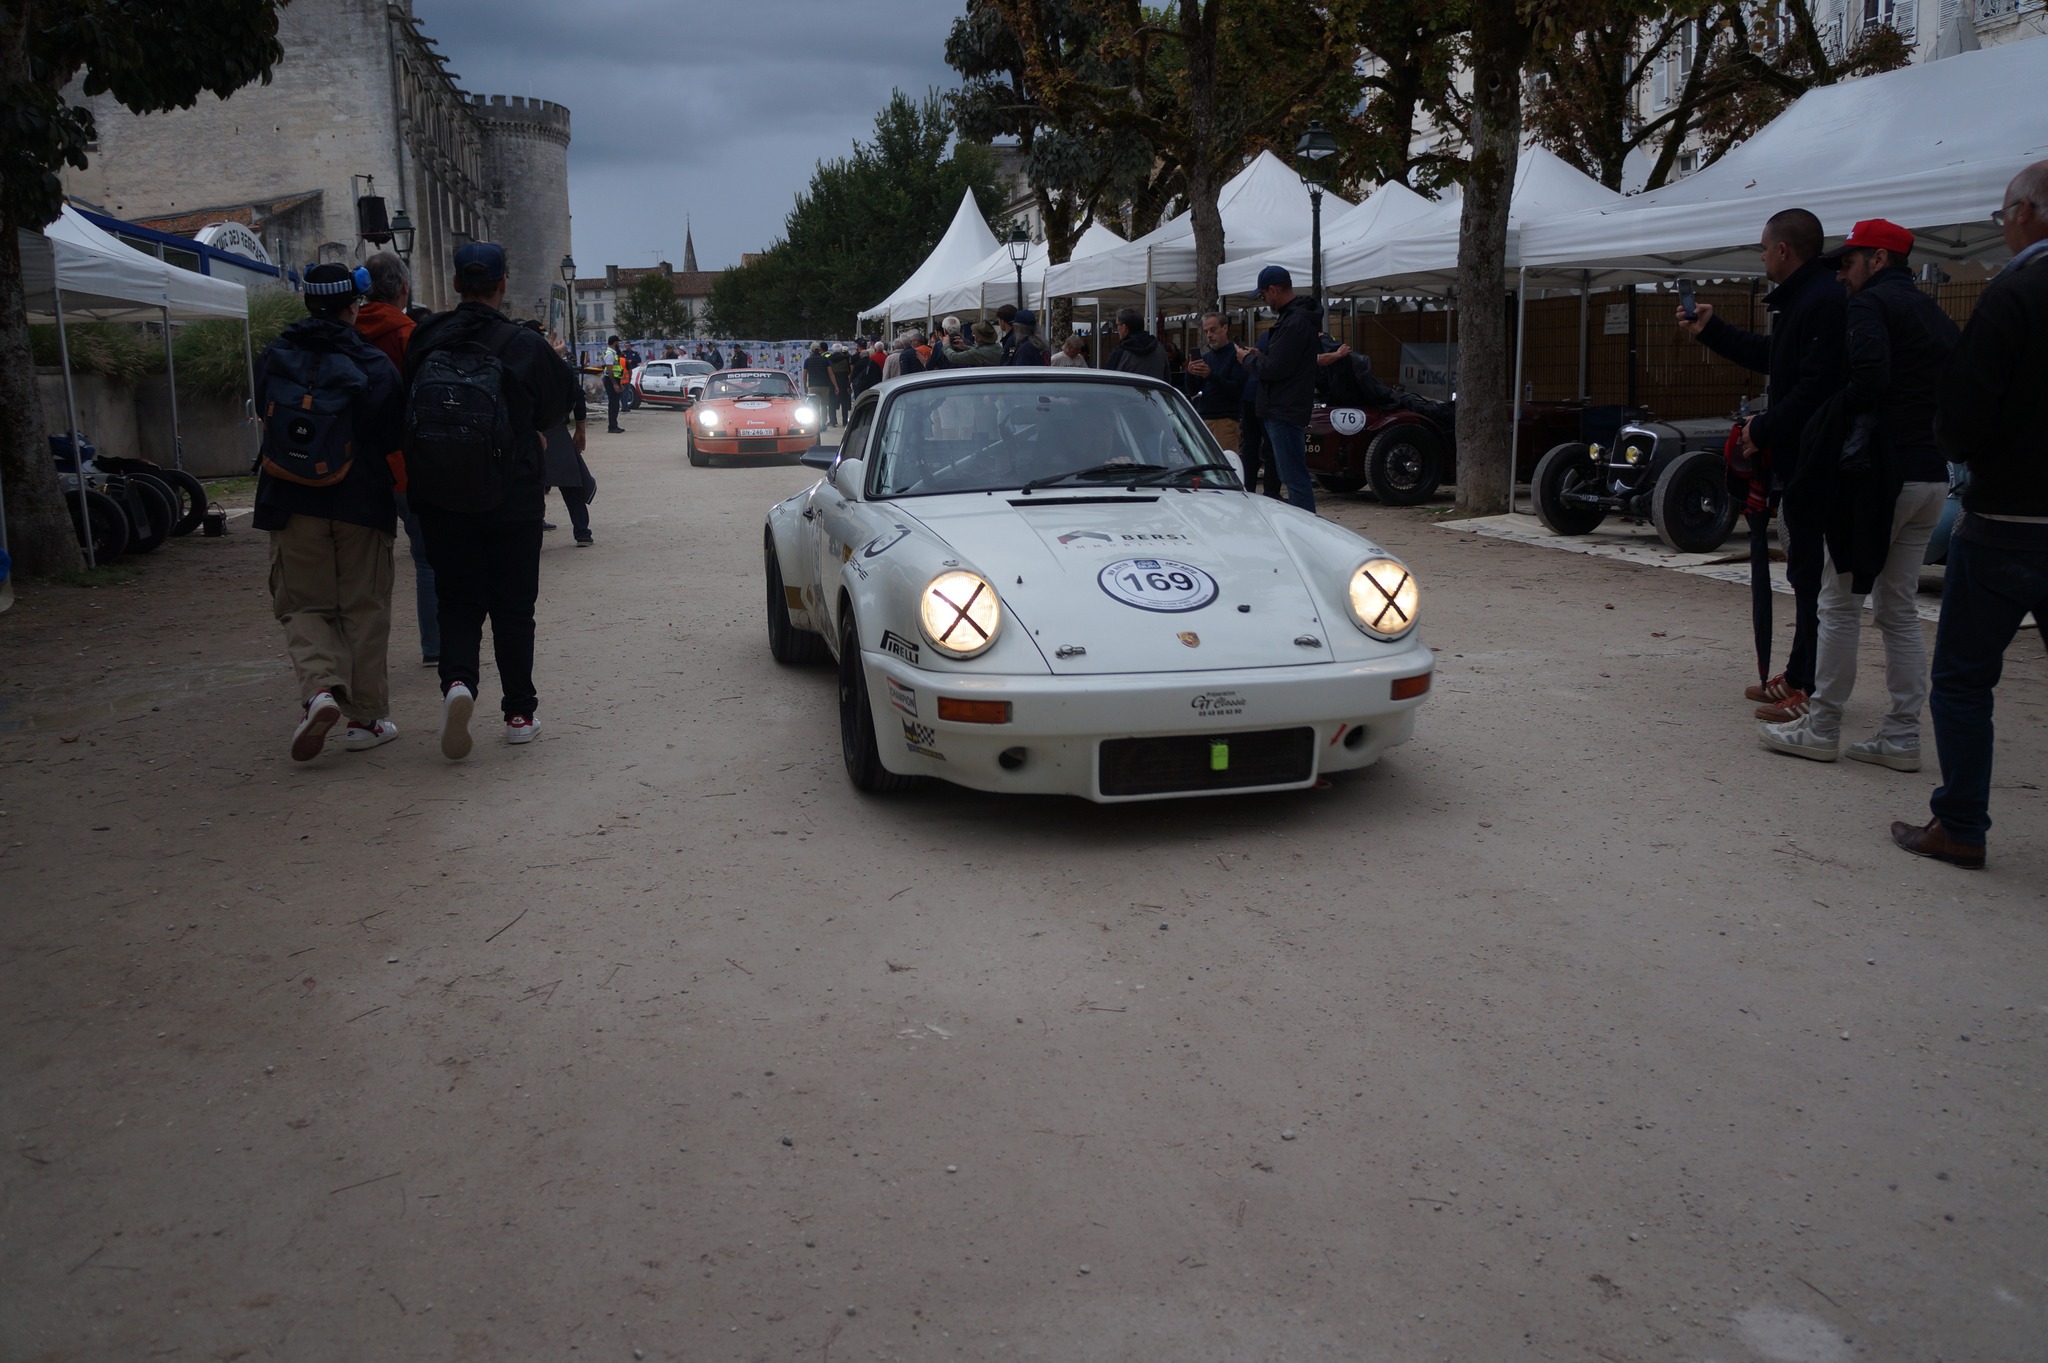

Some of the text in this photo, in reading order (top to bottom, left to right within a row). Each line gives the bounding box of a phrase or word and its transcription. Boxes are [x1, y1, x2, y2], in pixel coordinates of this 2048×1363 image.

[229, 229, 240, 245] DES
[1340, 412, 1356, 424] 76
[1064, 542, 1194, 550] IMMOBILIER
[1123, 572, 1193, 592] 169
[880, 629, 920, 665] PIRELLI
[889, 687, 916, 708] CHAMPION
[1191, 695, 1214, 709] GT
